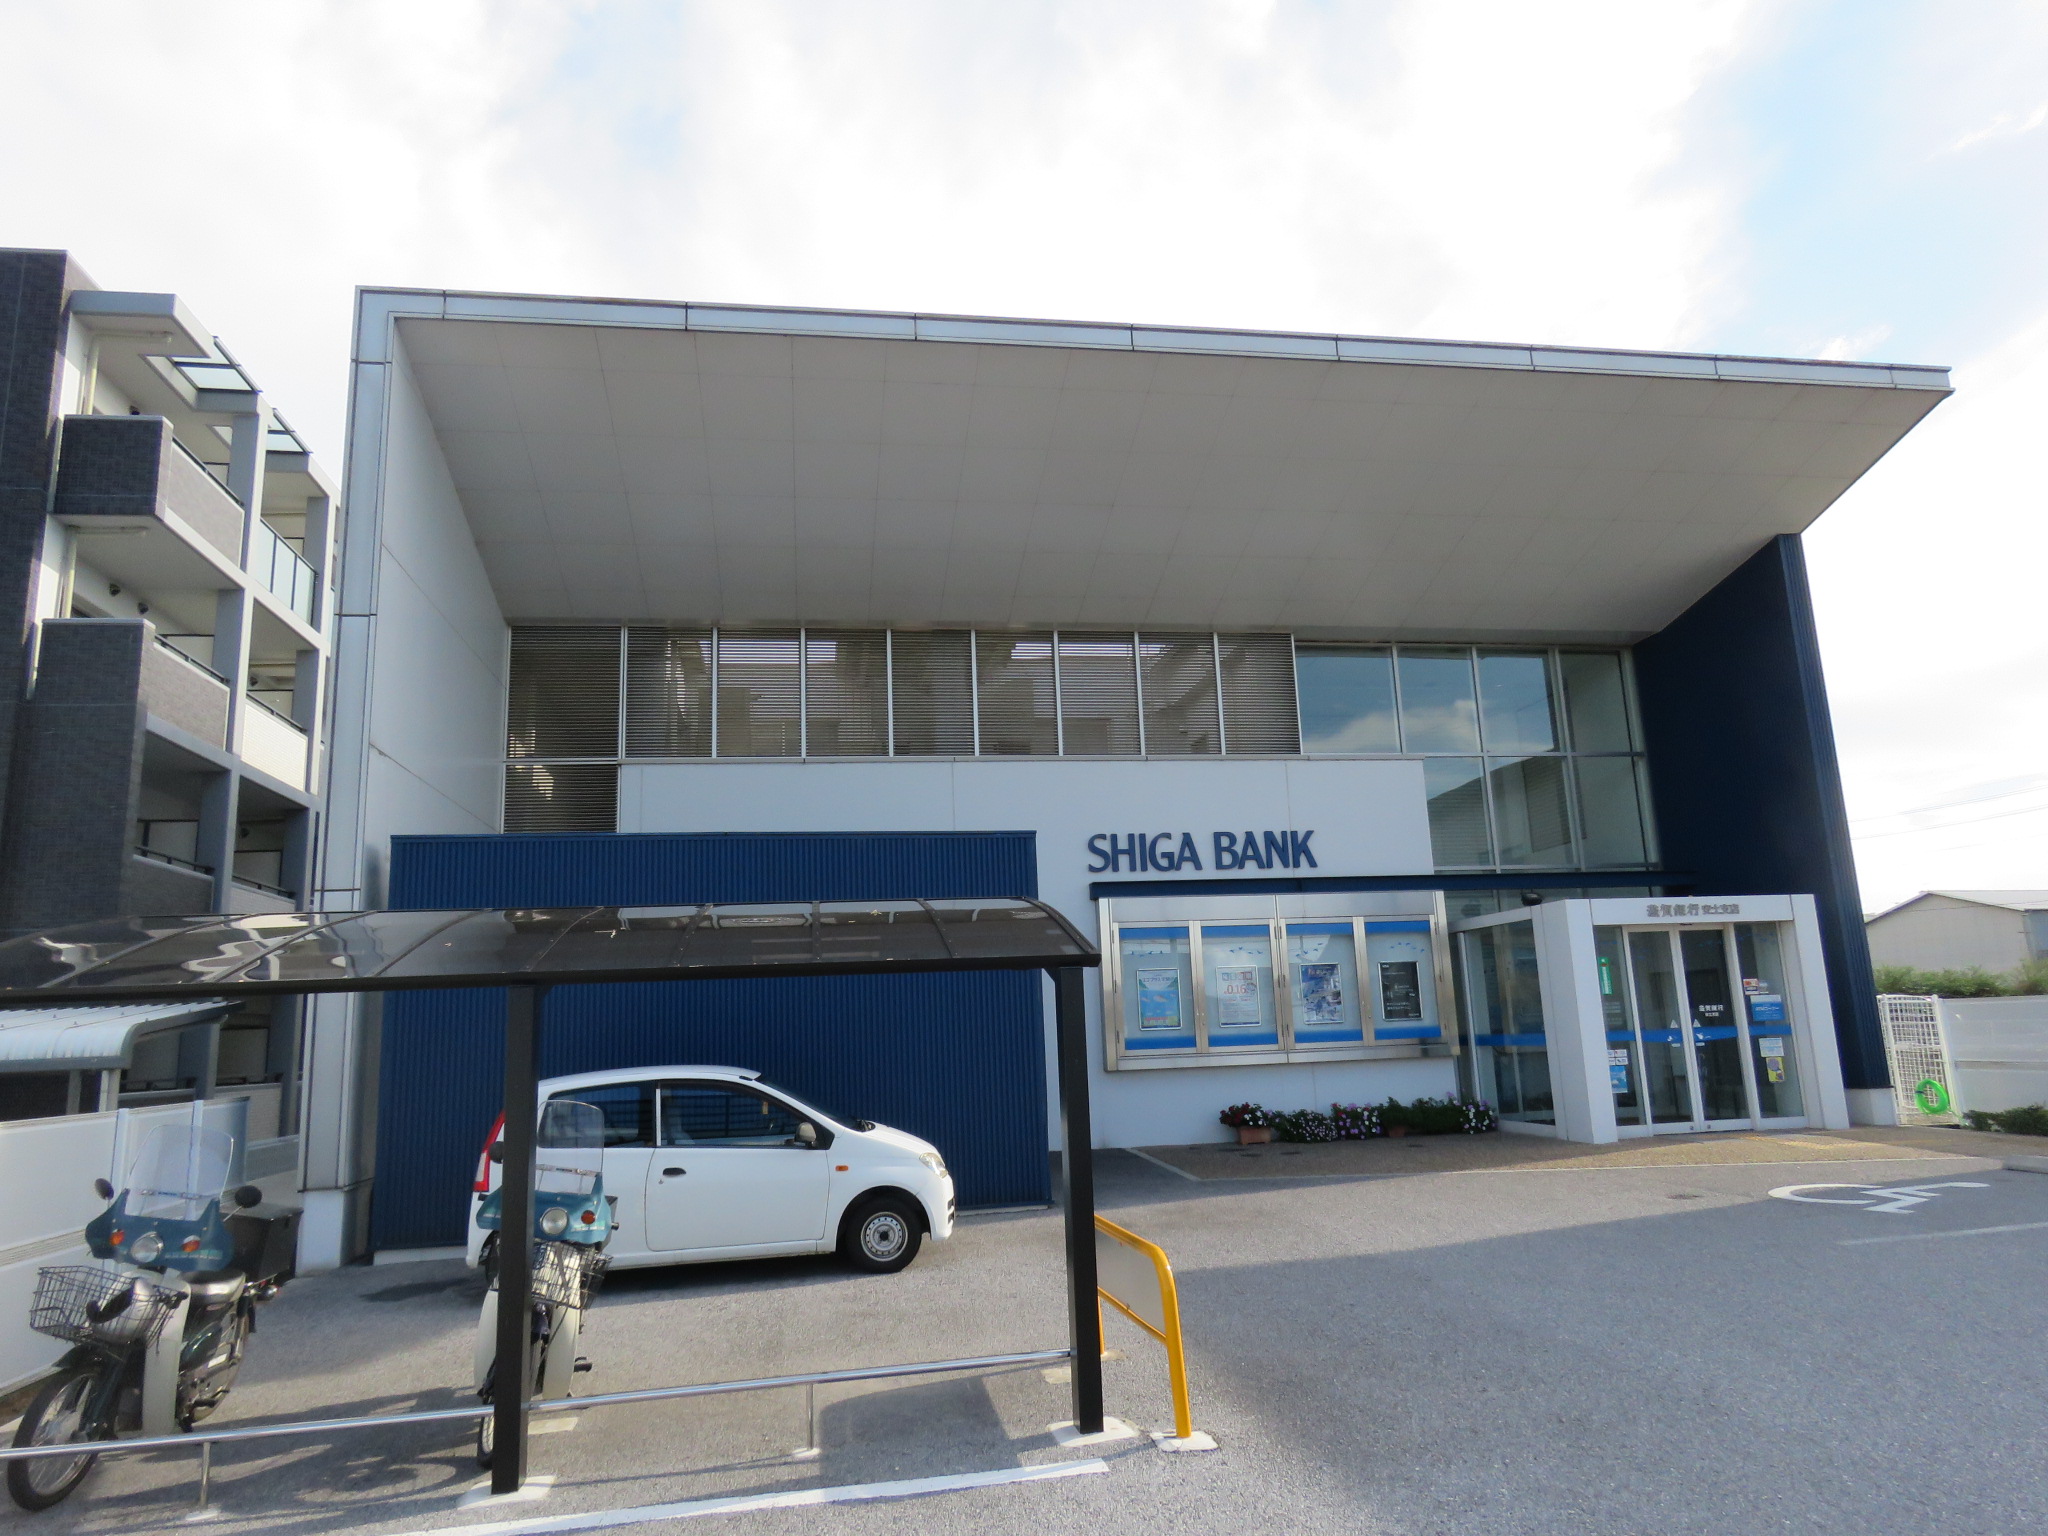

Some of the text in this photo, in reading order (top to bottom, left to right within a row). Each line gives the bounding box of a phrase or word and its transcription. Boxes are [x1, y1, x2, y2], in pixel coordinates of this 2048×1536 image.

[1088, 830, 1319, 873] SHIGA BANK
[1646, 903, 1700, 918] 滋賀銀行
